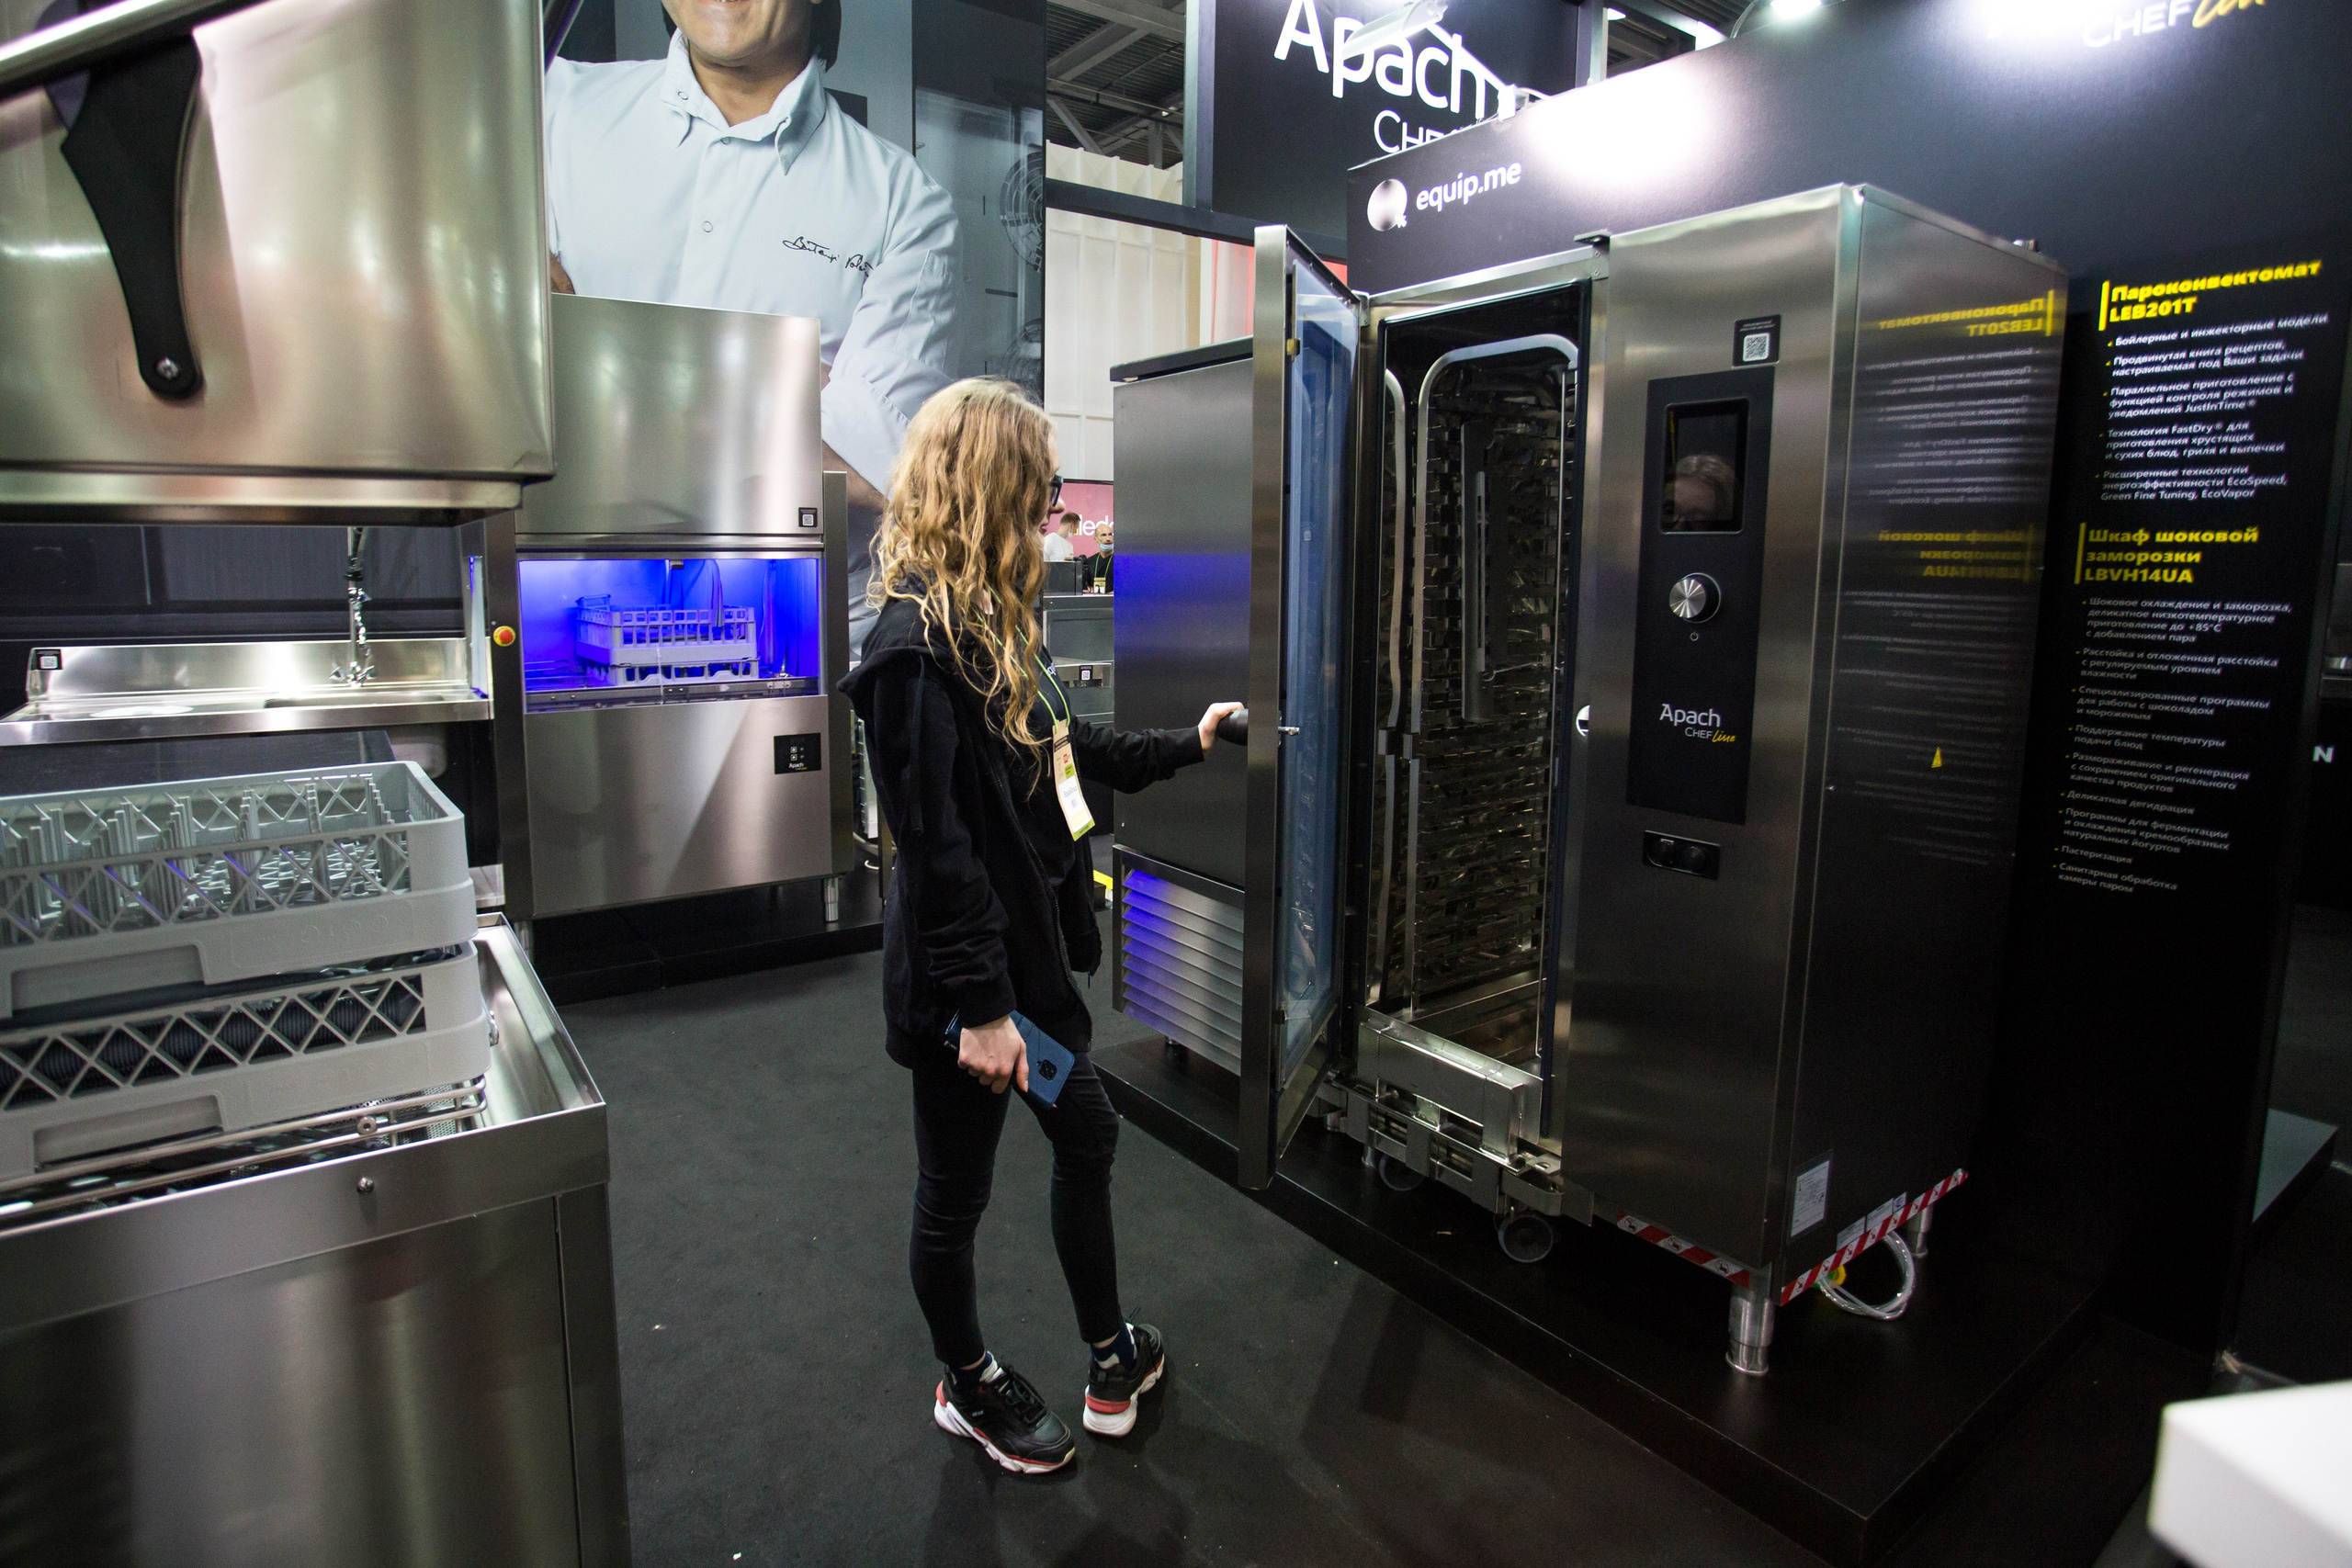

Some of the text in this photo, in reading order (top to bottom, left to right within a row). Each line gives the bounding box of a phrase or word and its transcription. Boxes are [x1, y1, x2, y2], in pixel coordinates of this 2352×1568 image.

[1274, 0, 1486, 119] Apach
[1416, 163, 1522, 212] equip.me
[2111, 260, 2322, 303] Пароконвектомат
[2115, 313, 2329, 347] Бойлерные и инжекторные модели
[2112, 350, 2304, 377] настраиваемая под Ваши задачи
[2113, 350, 2186, 367] Продвинутая
[2188, 347, 2222, 359] книга
[2110, 372, 2294, 397] Параллельное приготовление с
[2109, 384, 2293, 408] функцией контроля режимов и
[2108, 404, 2182, 420] уведомлений
[2108, 427, 2168, 438] Технология
[2226, 421, 2250, 433] для
[2106, 432, 2255, 450] приготовления хрустящих
[2106, 451, 2111, 460] и
[2113, 449, 2144, 460] сухих
[2183, 446, 2217, 457] гриля
[2219, 445, 2227, 454] и
[2230, 443, 2286, 456] выпечки
[2088, 525, 2260, 546] Шкаф шоковой
[2086, 551, 2202, 566] заморозки
[1659, 704, 1721, 727] Apach
[1685, 728, 1713, 739] CHEF
